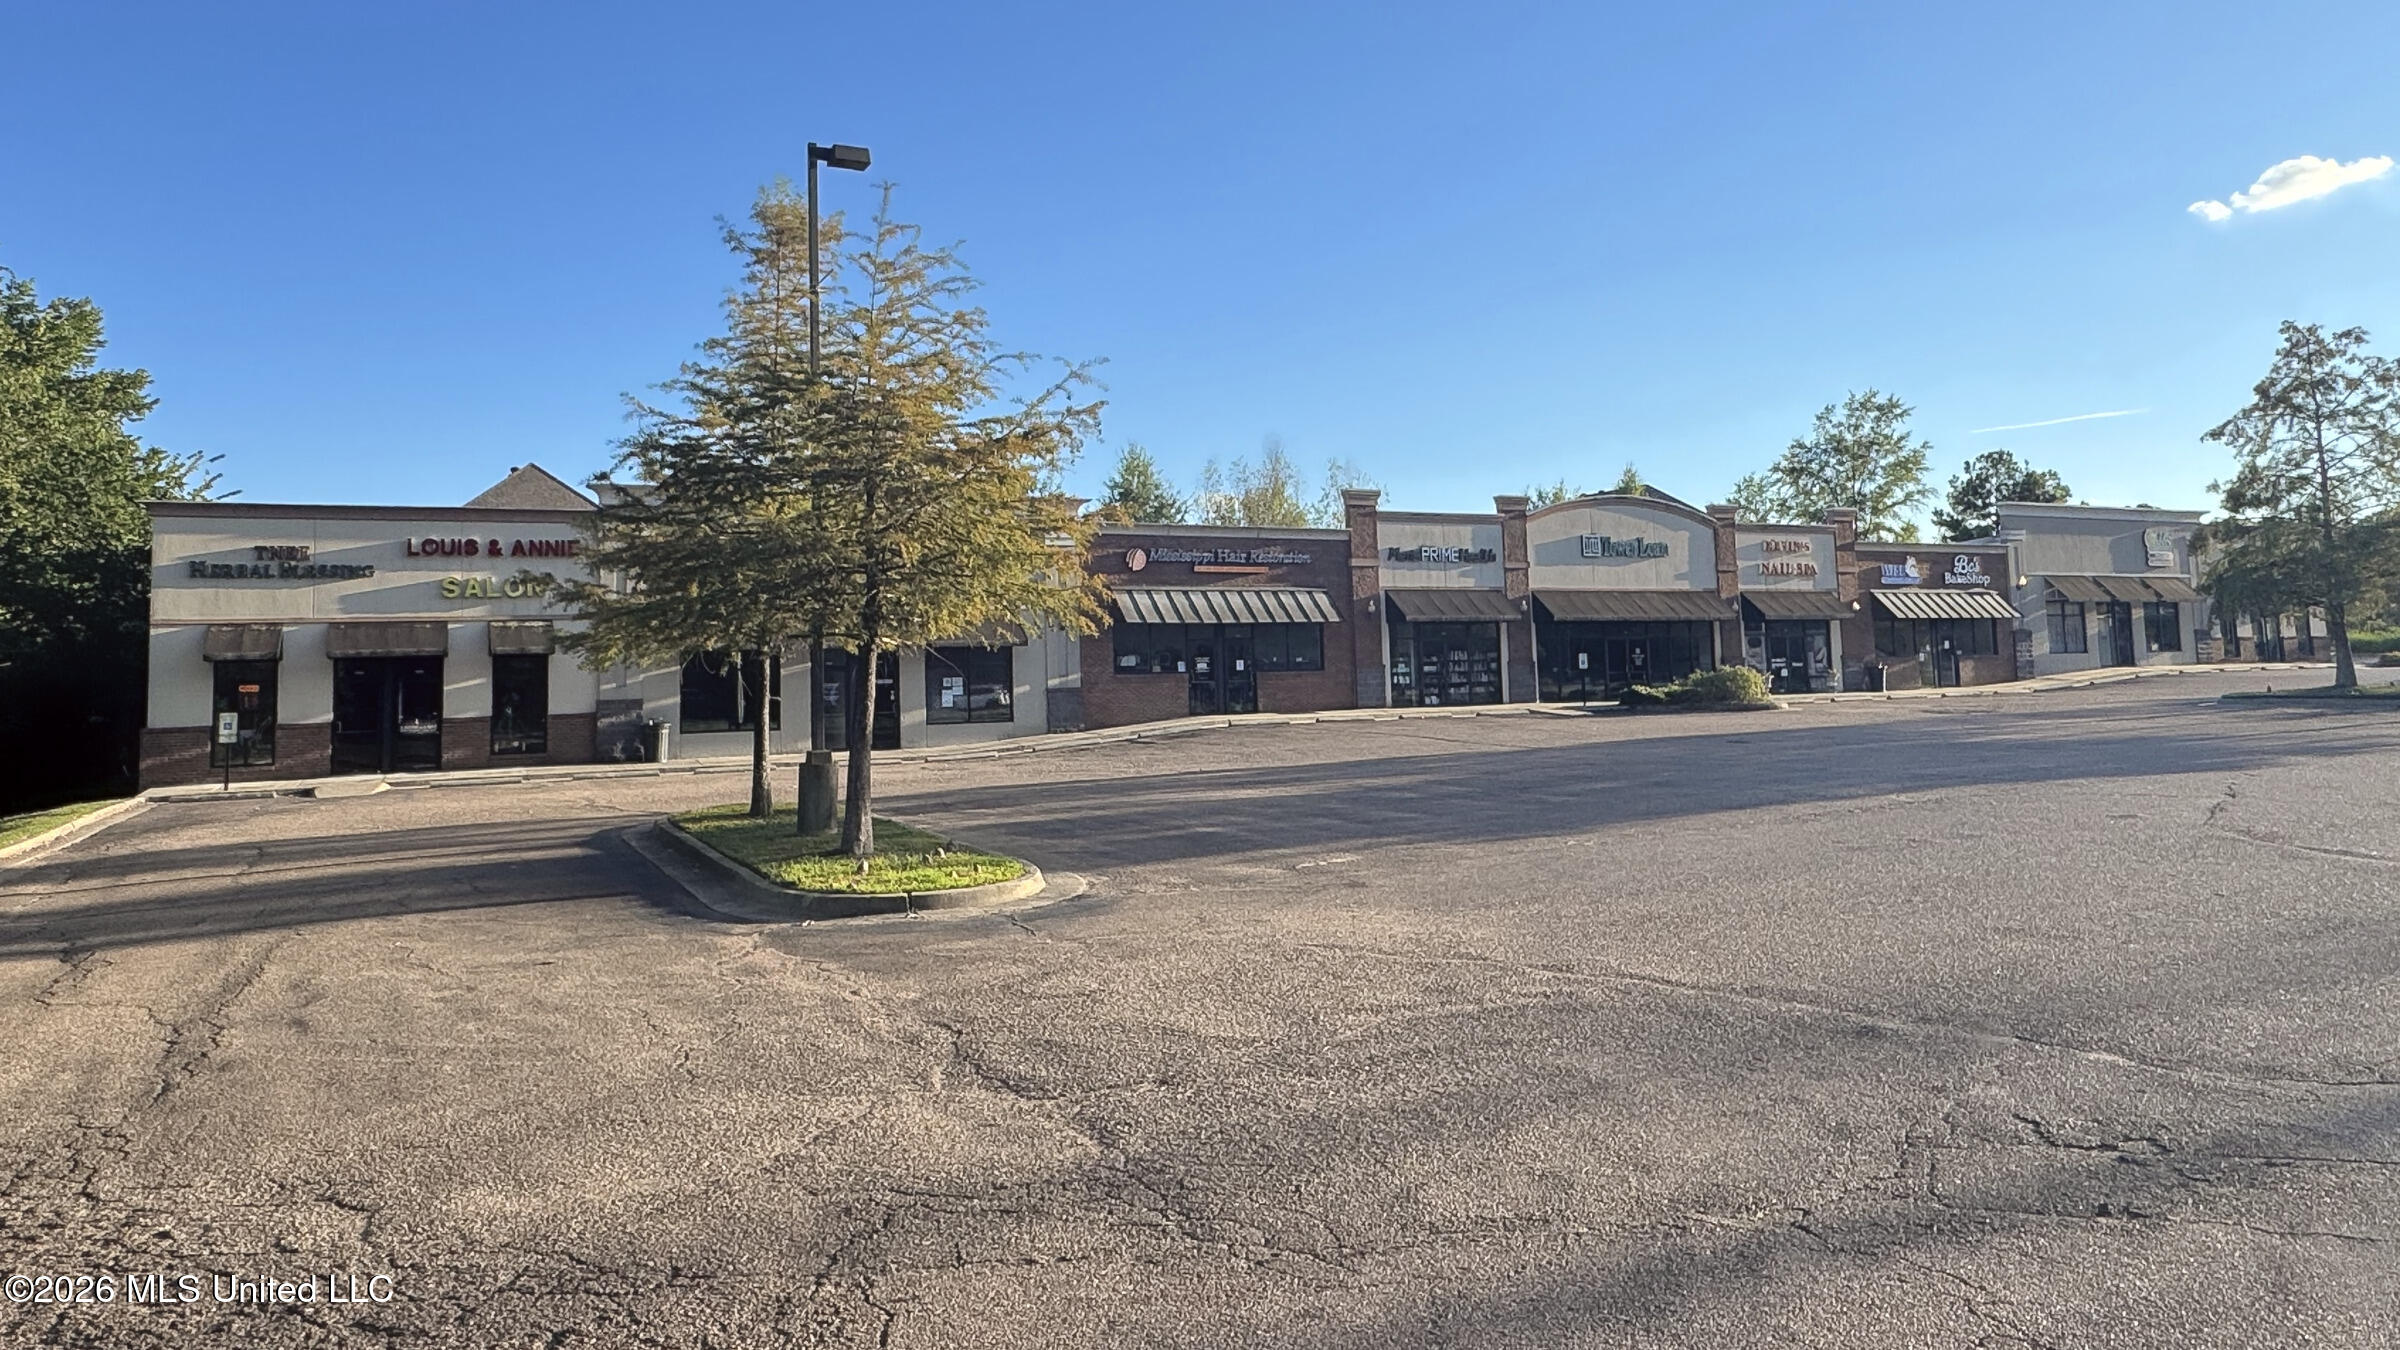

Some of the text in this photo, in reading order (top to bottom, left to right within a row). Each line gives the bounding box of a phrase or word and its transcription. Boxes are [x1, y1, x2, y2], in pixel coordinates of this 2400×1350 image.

[407, 538, 581, 557] LOUIS & ANNIE
[1149, 547, 1311, 564] Mississippi Hair Restoration
[1420, 546, 1460, 563] PRIME
[1758, 562, 1818, 577] NAIL SPA
